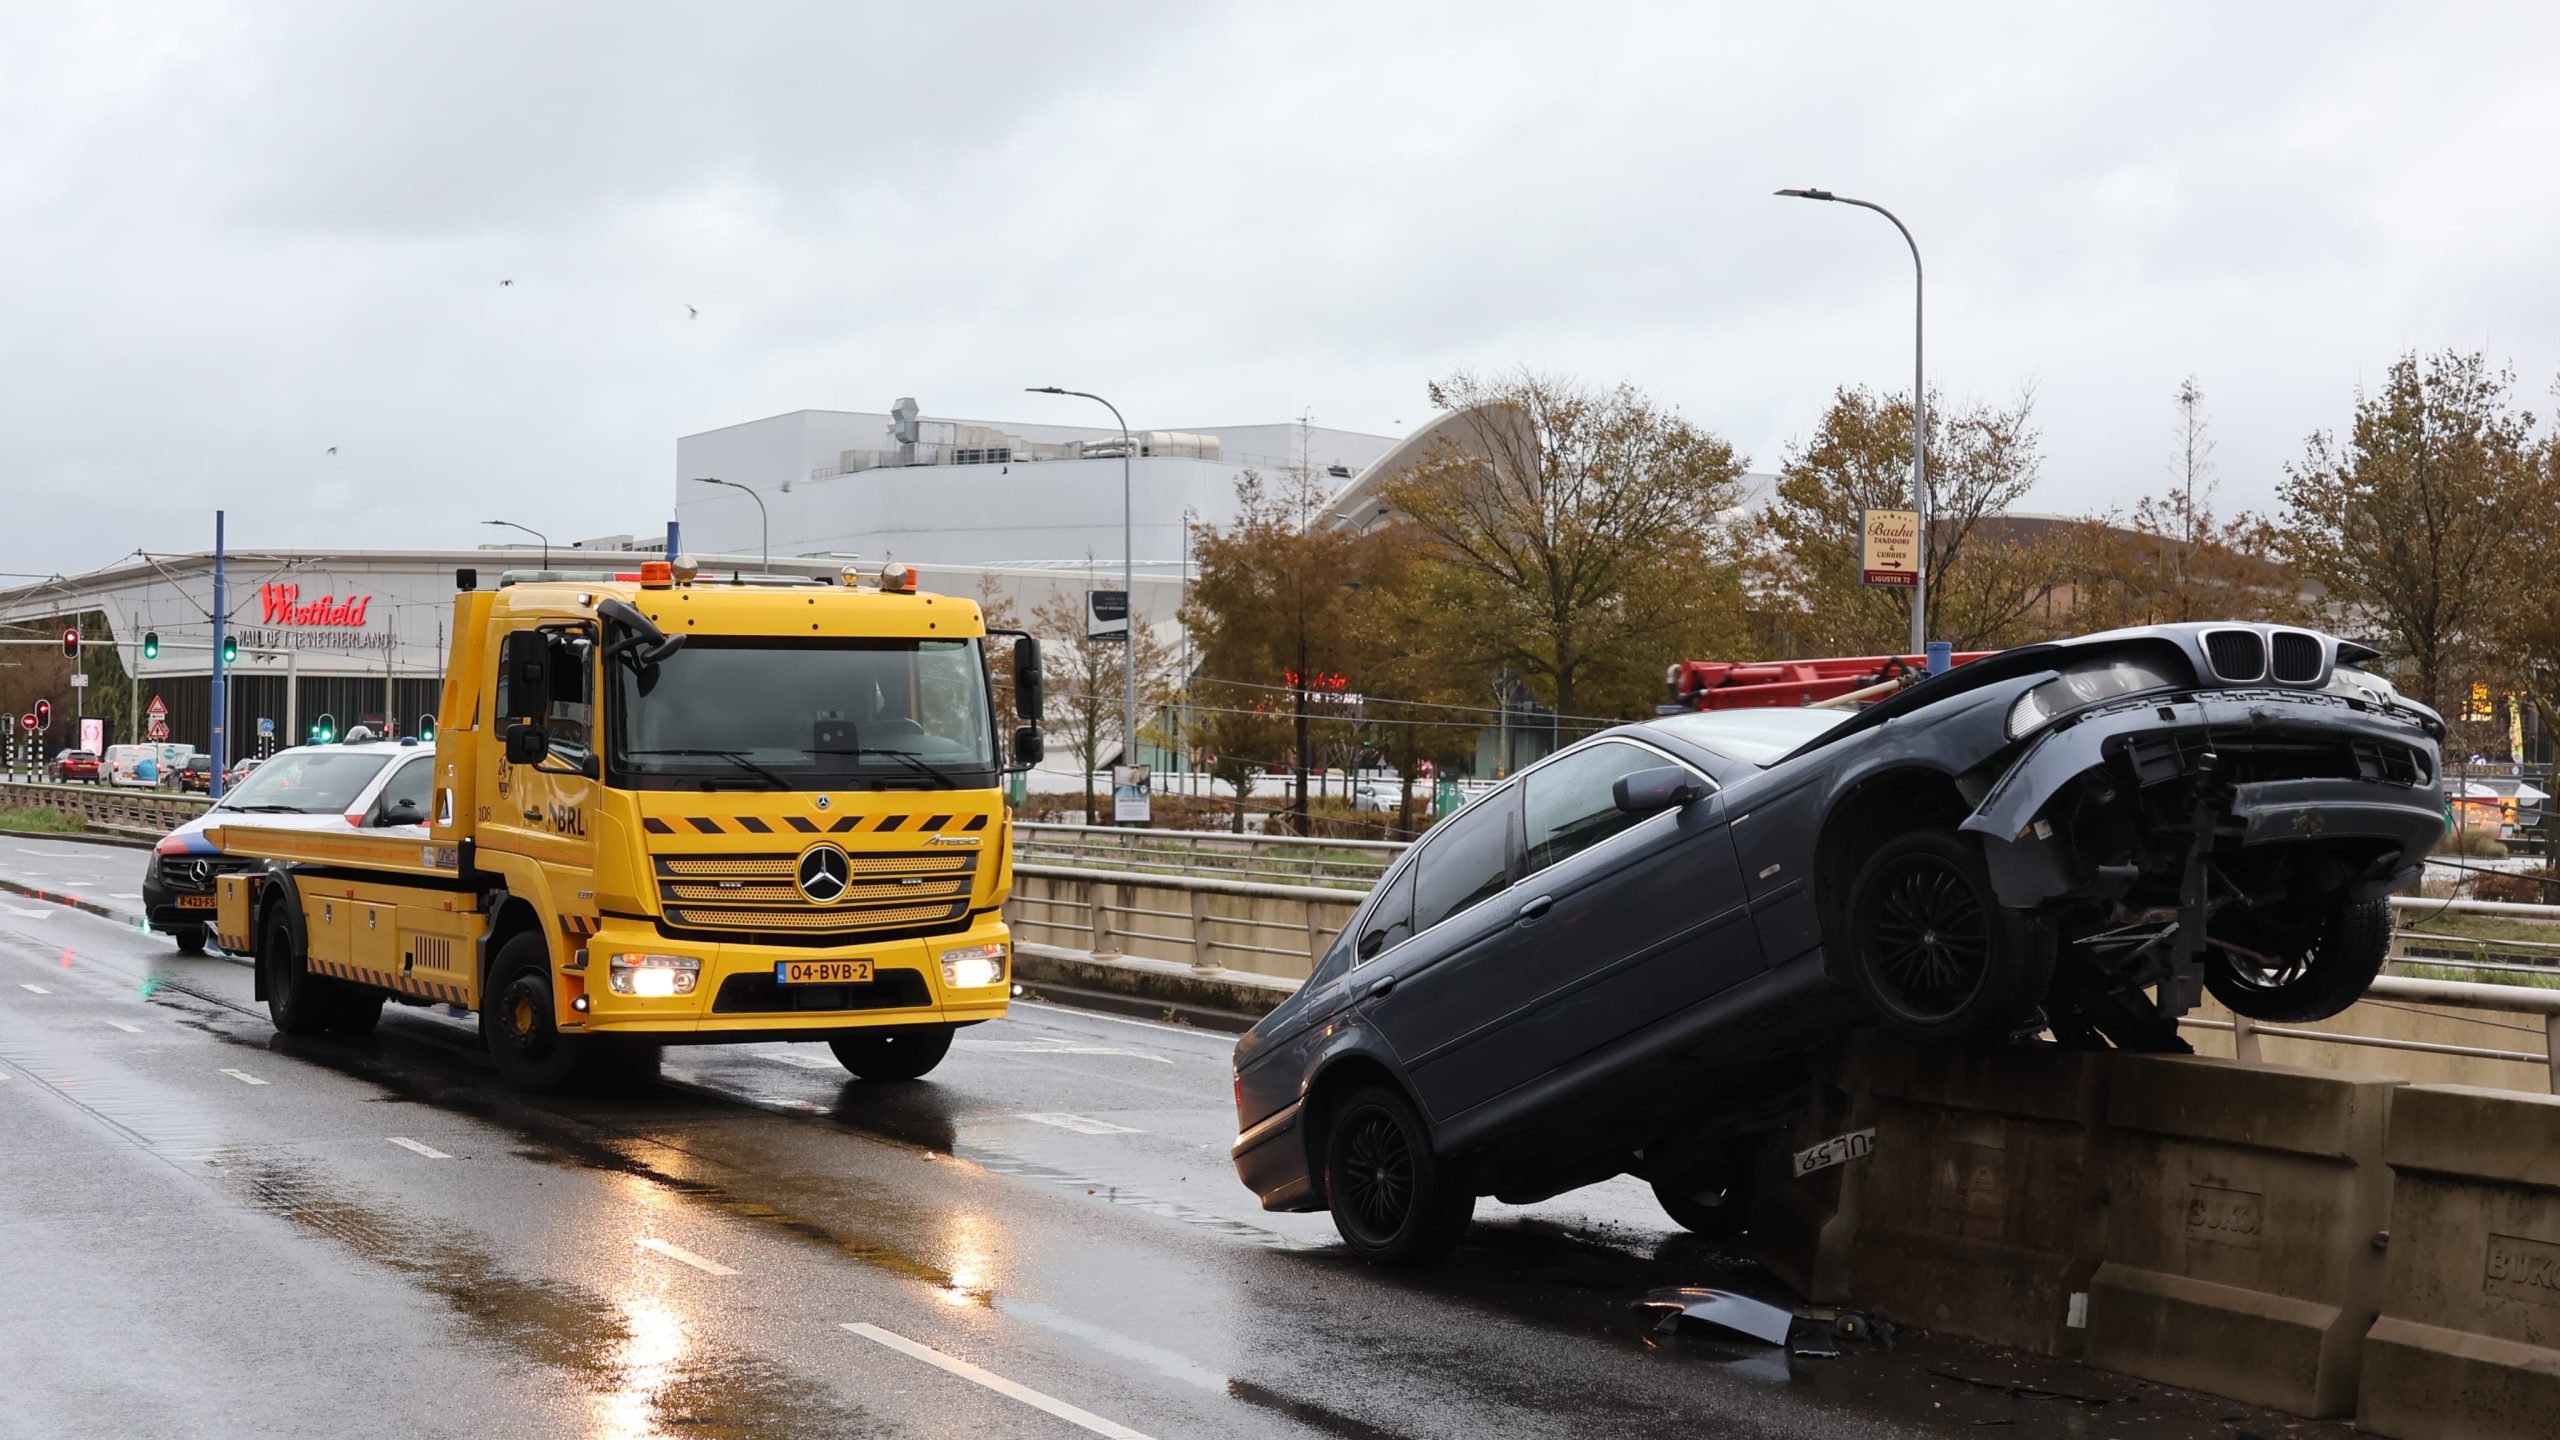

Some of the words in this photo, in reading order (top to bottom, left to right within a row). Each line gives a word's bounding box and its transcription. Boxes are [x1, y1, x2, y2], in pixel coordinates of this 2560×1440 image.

[1868, 522, 1913, 538] Baahu
[1874, 537, 1910, 545] TANDOORI
[1876, 551, 1907, 559] CURRIES
[1871, 575, 1902, 584] LIGUSTER
[1902, 576, 1911, 584] 72
[260, 583, 372, 627] Westfield
[239, 630, 262, 647] MALL
[267, 630, 280, 647] OF
[306, 631, 397, 650] NETHERLANDS
[180, 896, 216, 908] R-423-FS
[791, 964, 868, 980] 04-BVB-2
